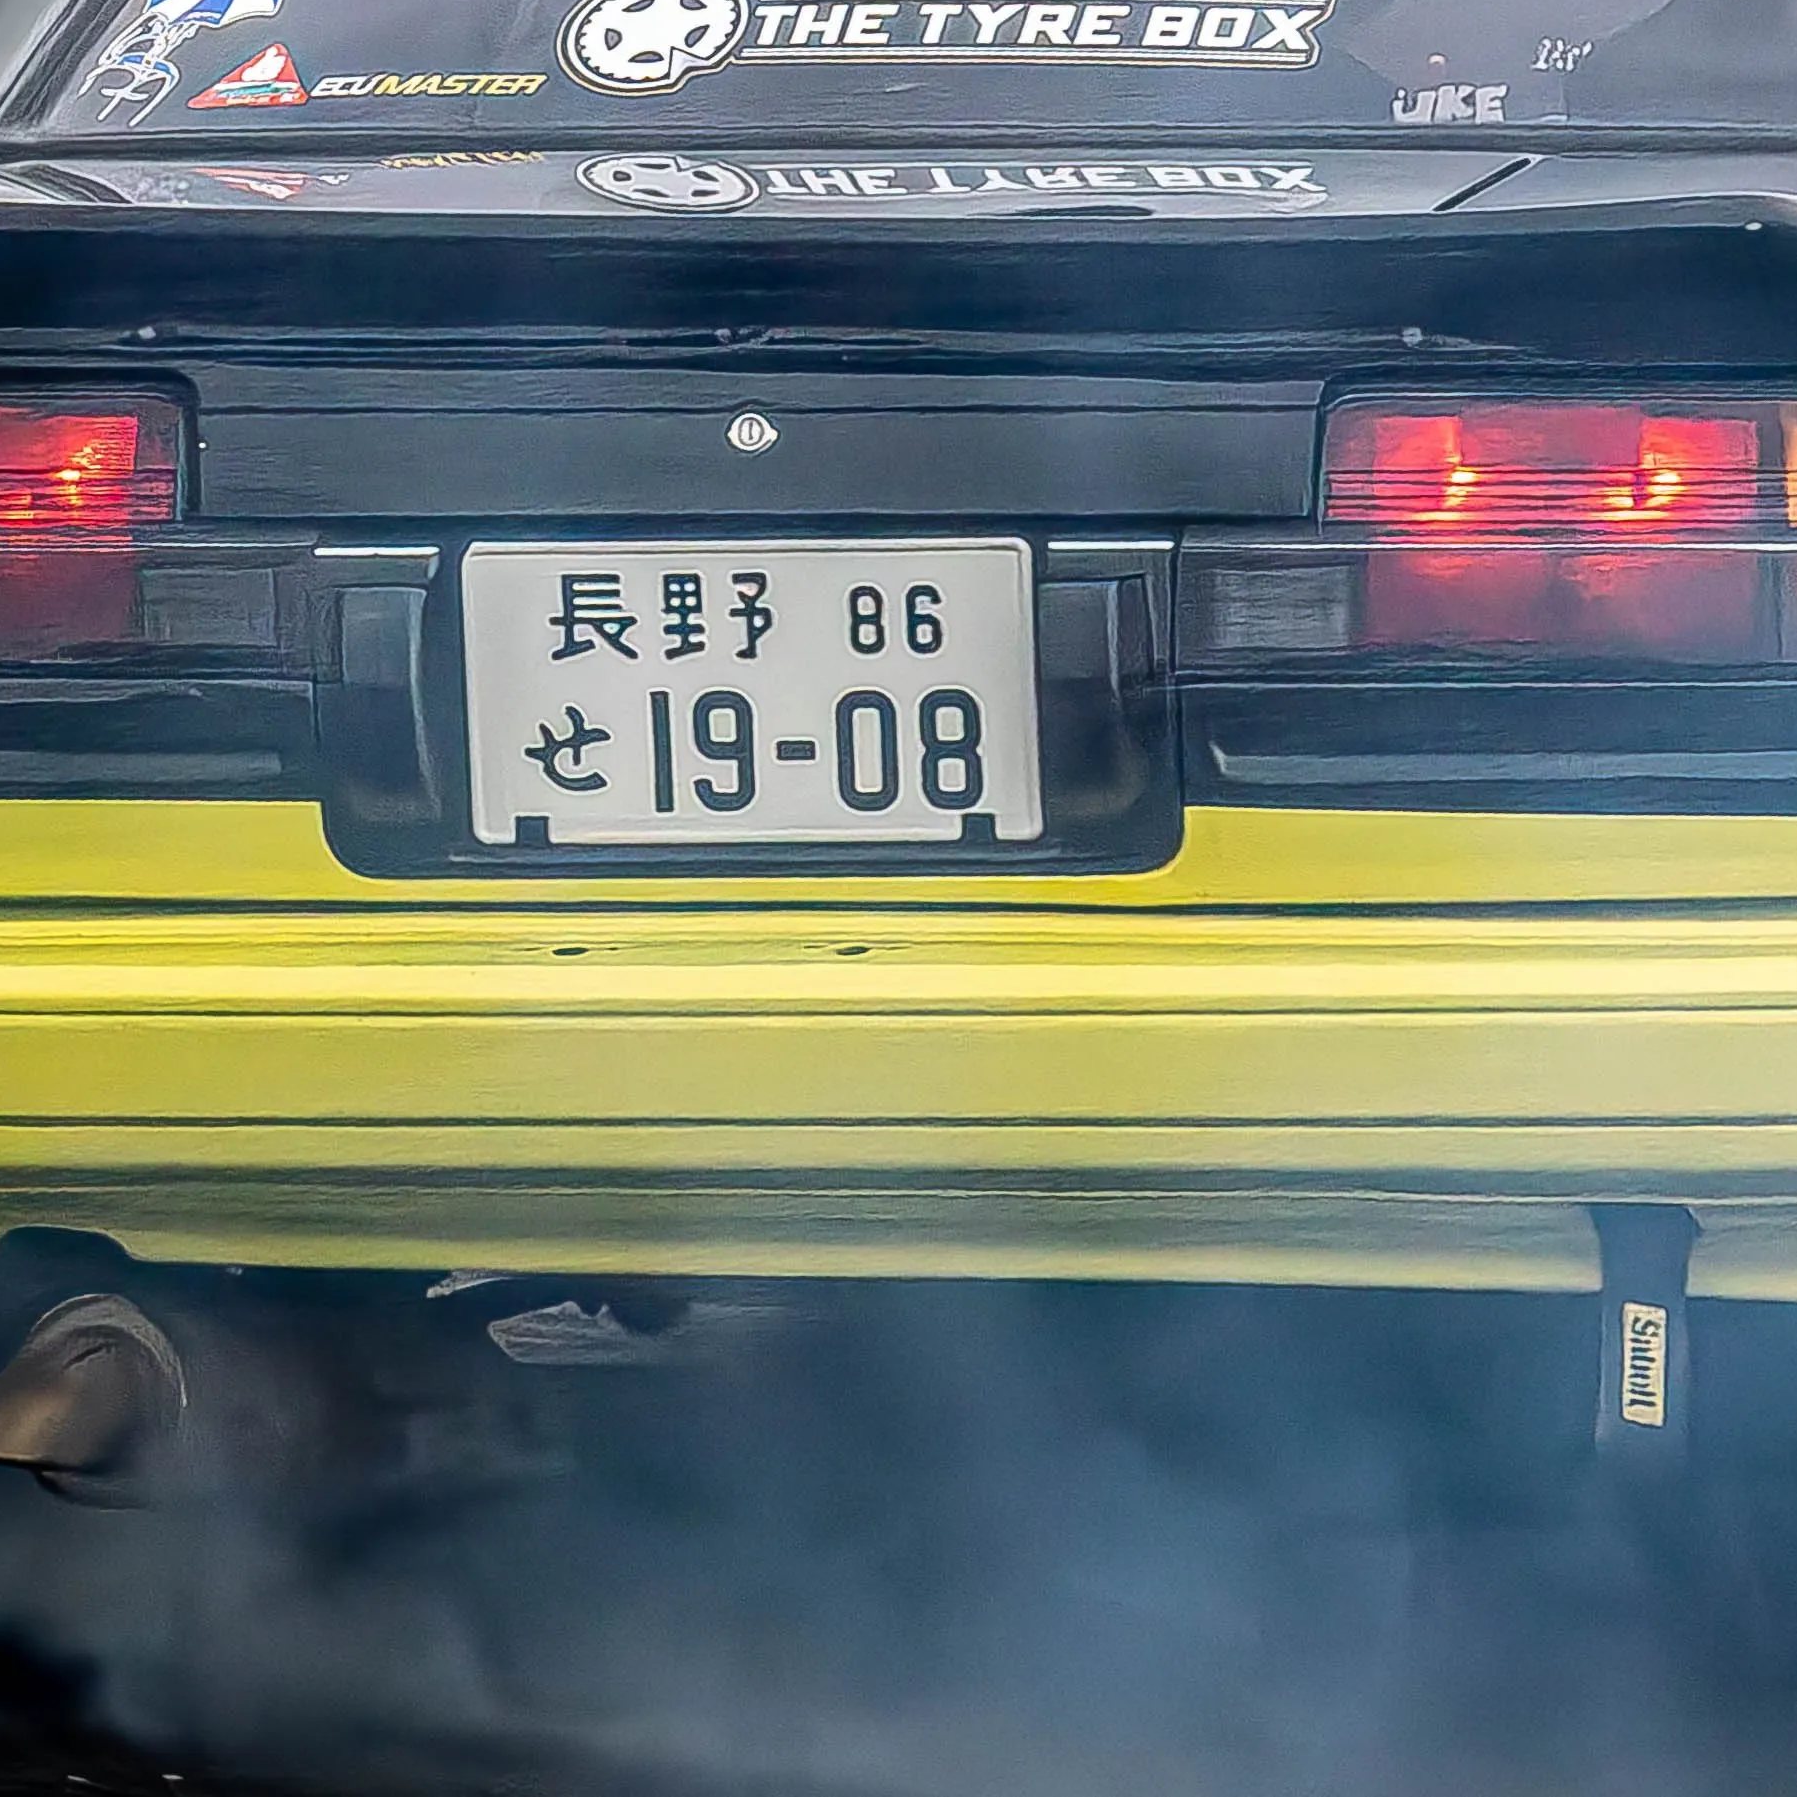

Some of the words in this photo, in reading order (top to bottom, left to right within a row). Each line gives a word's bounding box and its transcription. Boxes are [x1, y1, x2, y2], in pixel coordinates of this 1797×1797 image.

[753, 3, 900, 47] THE
[919, 4, 1131, 47] TYRE
[1141, 4, 1321, 52] BOX
[309, 72, 549, 97] ECUMASTER
[549, 572, 773, 660] 長野
[848, 584, 944, 654] 86
[524, 705, 611, 791] せ
[649, 688, 983, 813] 19-08
